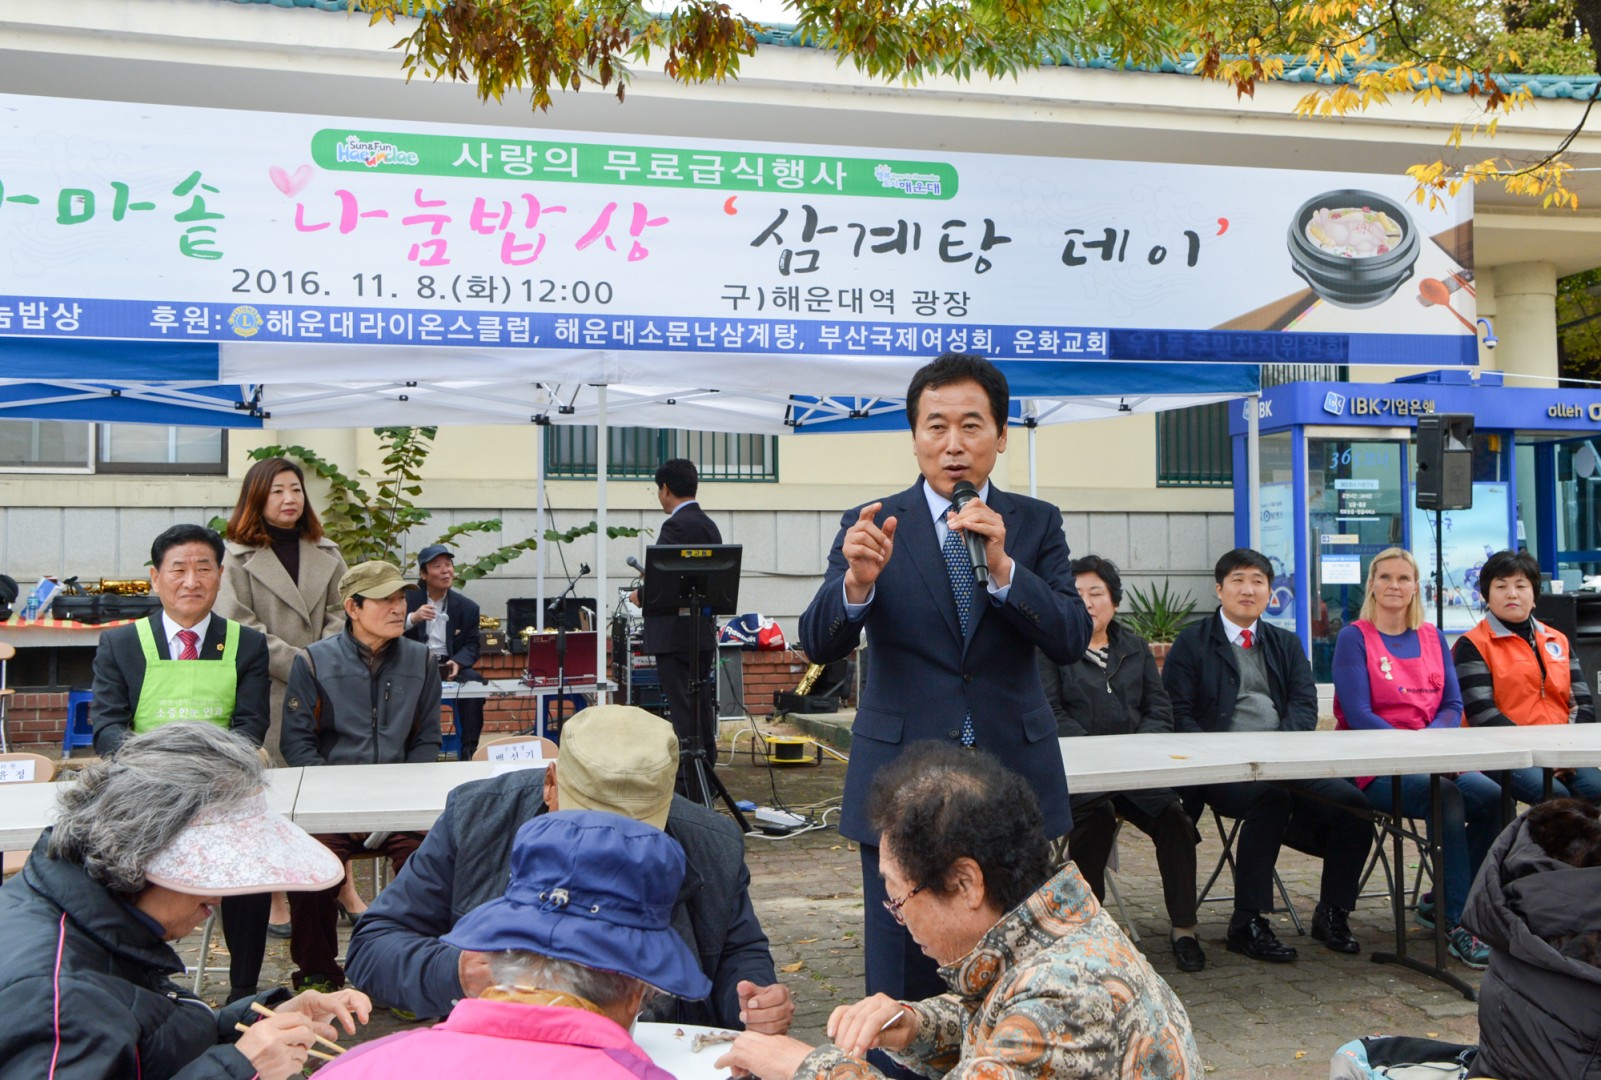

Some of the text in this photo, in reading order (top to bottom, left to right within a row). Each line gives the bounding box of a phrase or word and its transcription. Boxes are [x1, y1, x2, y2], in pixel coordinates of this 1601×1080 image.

[337, 143, 418, 166] Haeundae
[349, 140, 392, 152] Sun&Fun
[452, 142, 847, 191] 사랑의 무료급식행사
[899, 179, 940, 195] 해운대
[295, 187, 670, 266] 나눔밥상
[231, 268, 331, 297] 2016.
[352, 273, 398, 298] 11.
[720, 284, 971, 317] 구)해운대역 광장
[149, 305, 222, 335] 후원:
[266, 308, 541, 345] 해운대라이온스클럽,
[554, 317, 805, 351] 해운대소문난삼계탕,
[817, 325, 1001, 356] 부산국제여성회,
[1012, 328, 1108, 355] 운화교회
[1259, 400, 1273, 418] BK
[1548, 402, 1583, 418] olleh
[725, 625, 757, 643] Reebok
